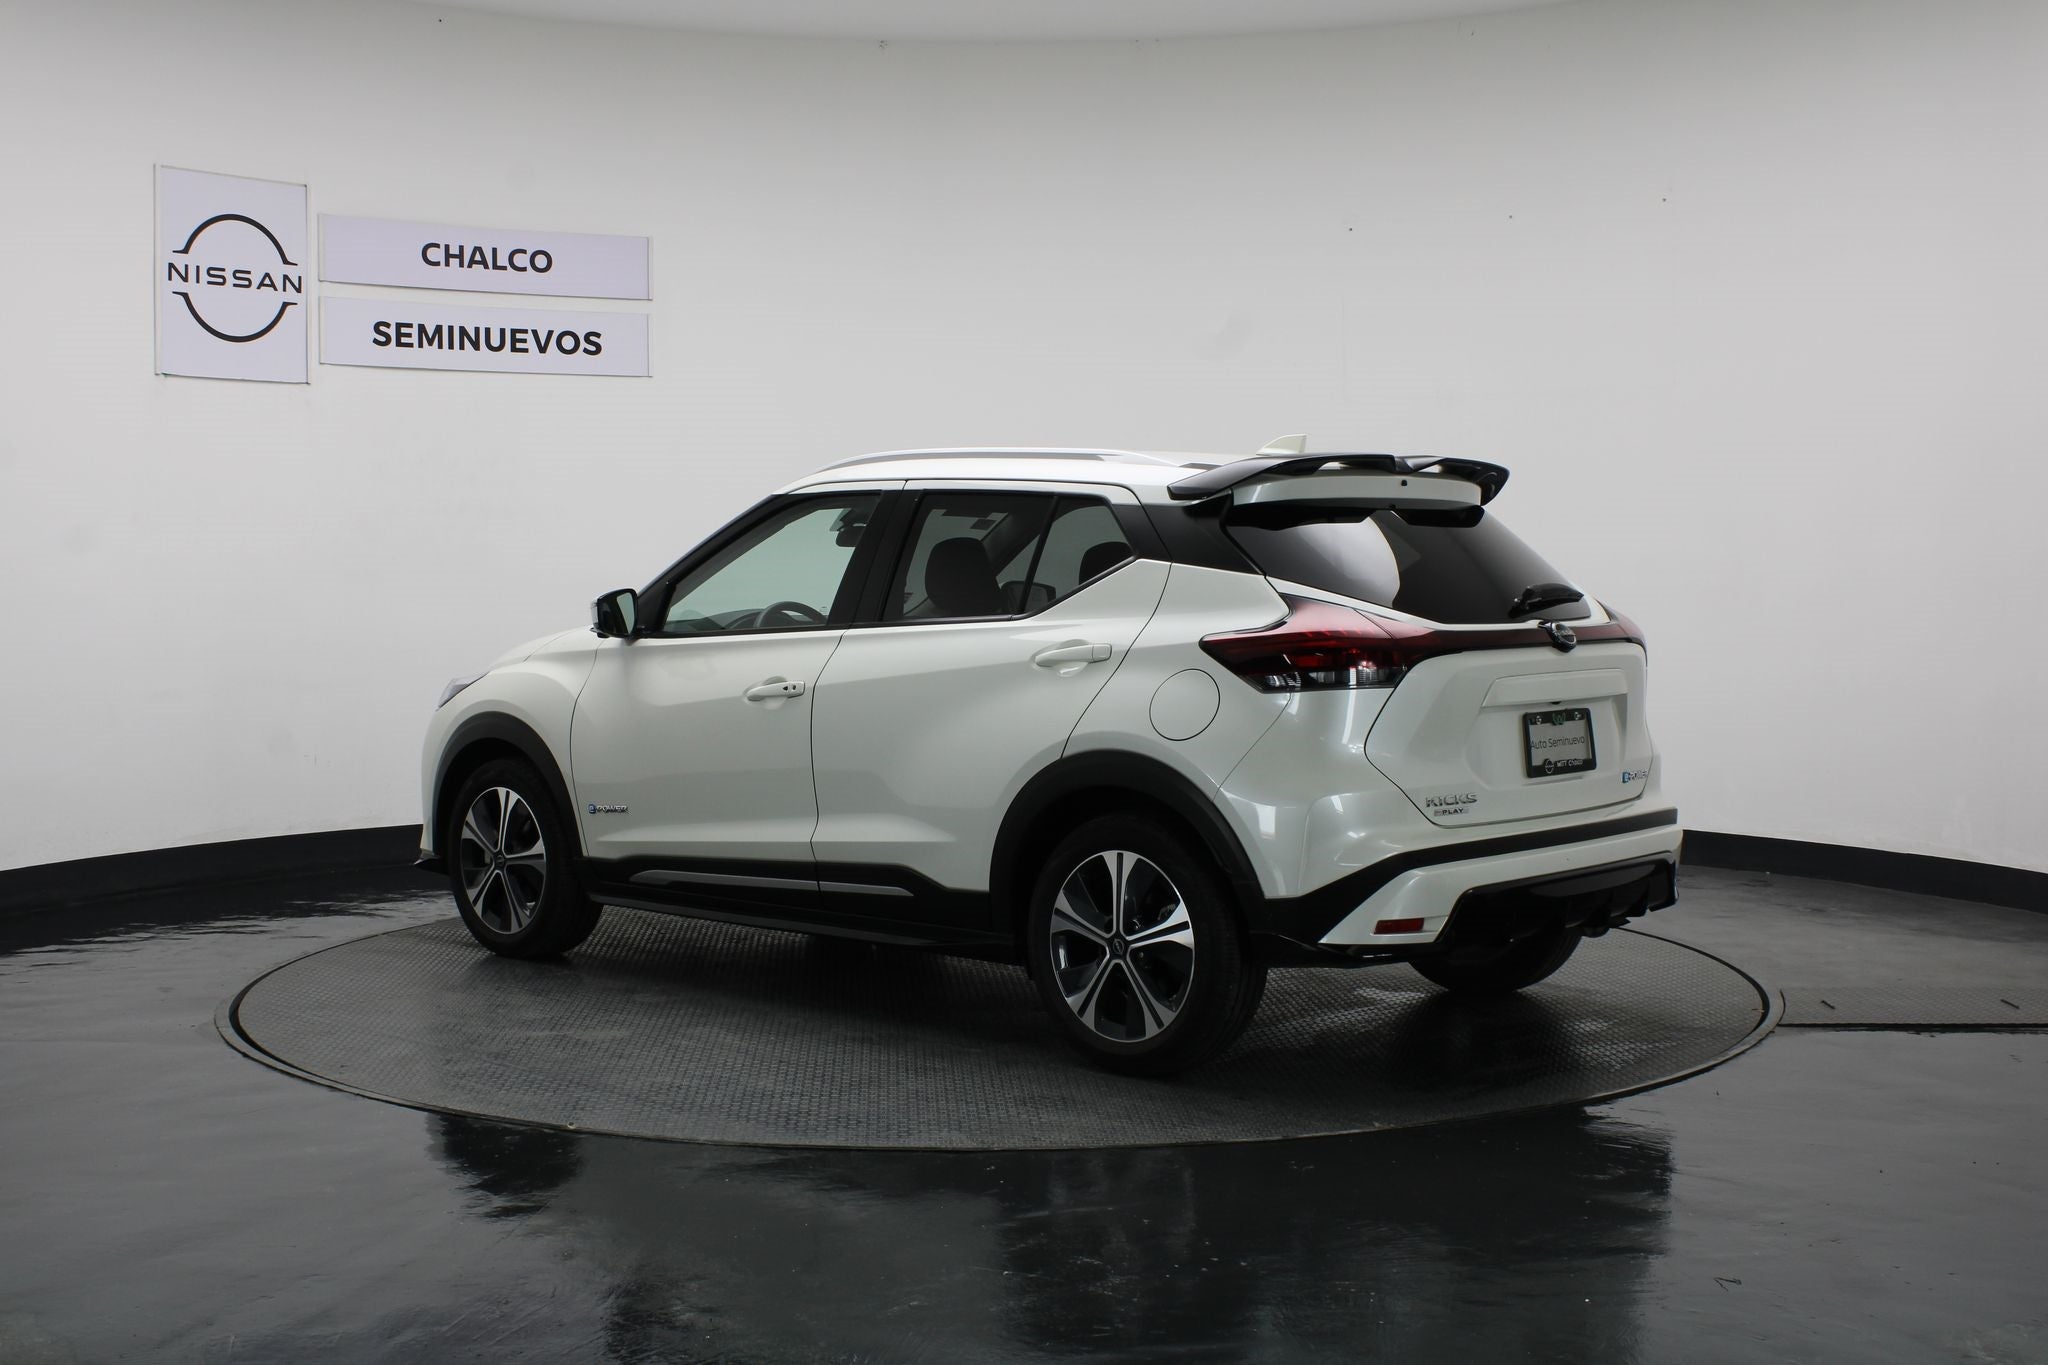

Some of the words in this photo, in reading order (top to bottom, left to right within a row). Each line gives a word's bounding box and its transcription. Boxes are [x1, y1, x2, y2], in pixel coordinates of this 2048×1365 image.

[421, 242, 553, 274] CHALCO
[168, 262, 302, 294] NISSAN
[372, 320, 603, 356] SEMINUEVOS
[1548, 736, 1585, 748] Seminuevo
[1425, 793, 1478, 808] KICKS
